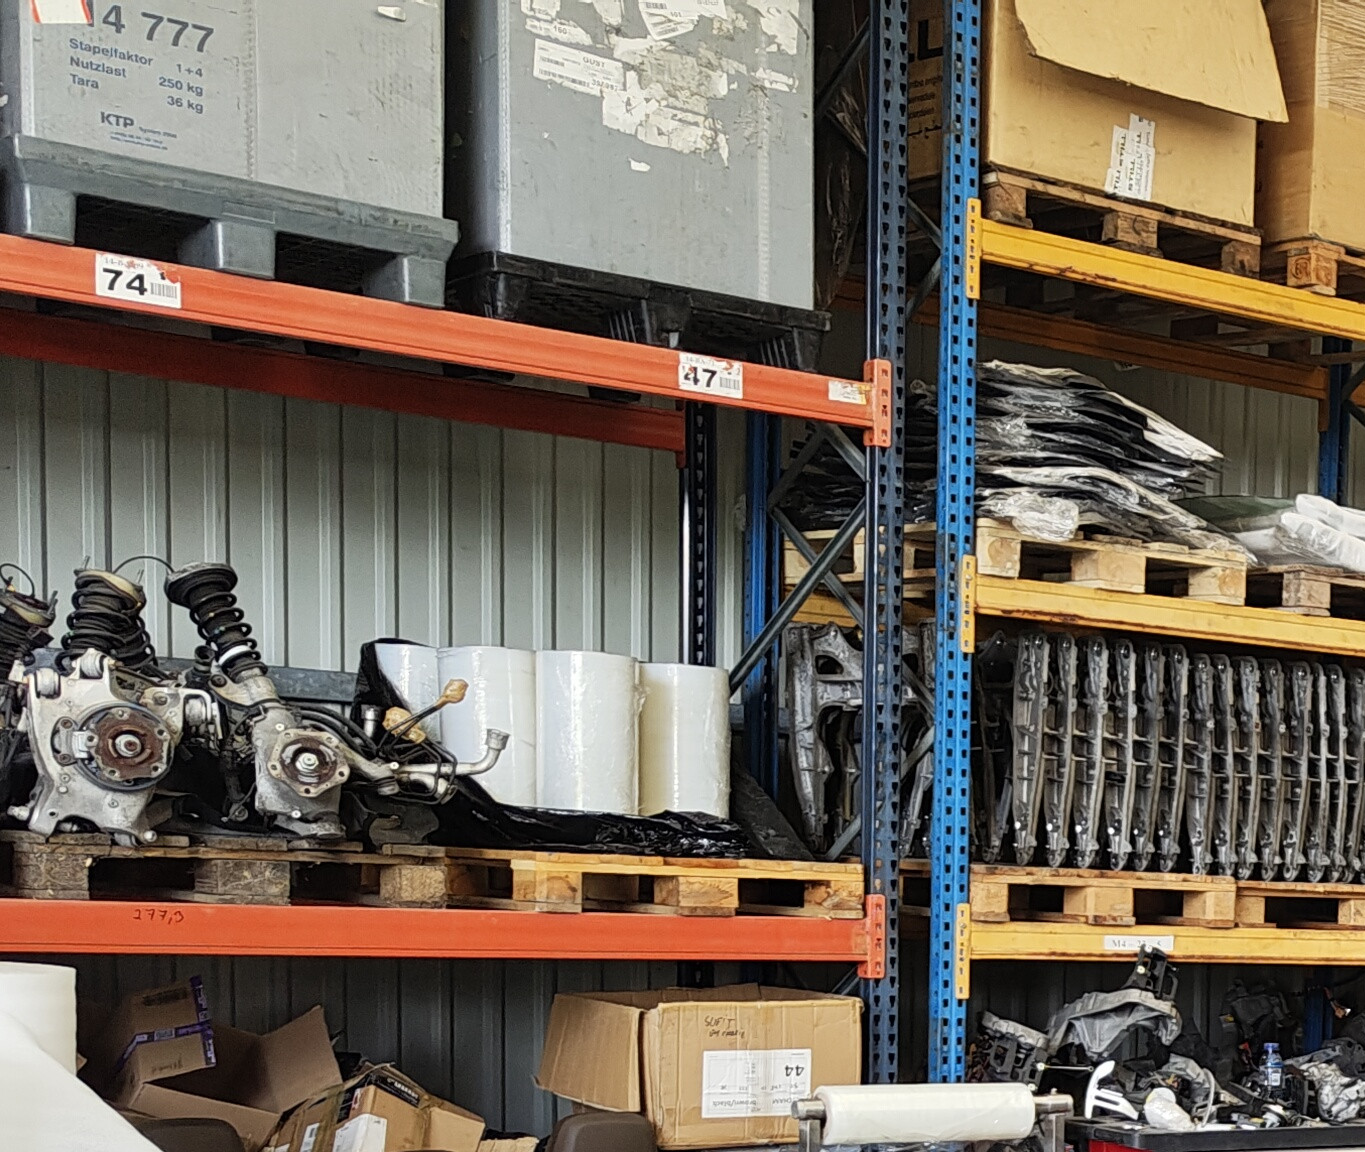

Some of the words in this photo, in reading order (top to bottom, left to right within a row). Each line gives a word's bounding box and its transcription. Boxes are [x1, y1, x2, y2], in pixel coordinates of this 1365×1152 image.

[141, 11, 215, 53] 777
[69, 37, 154, 66] Stapelfaktor
[69, 55, 127, 78] Nutzlast
[158, 76, 183, 91] 250
[187, 84, 204, 97] kg
[69, 73, 100, 90] Tara
[166, 95, 184, 108] 36
[187, 101, 204, 115] kg
[100, 111, 135, 128] KTP
[102, 267, 148, 296] 74
[683, 366, 717, 388] 47
[785, 1064, 805, 1077] 44
